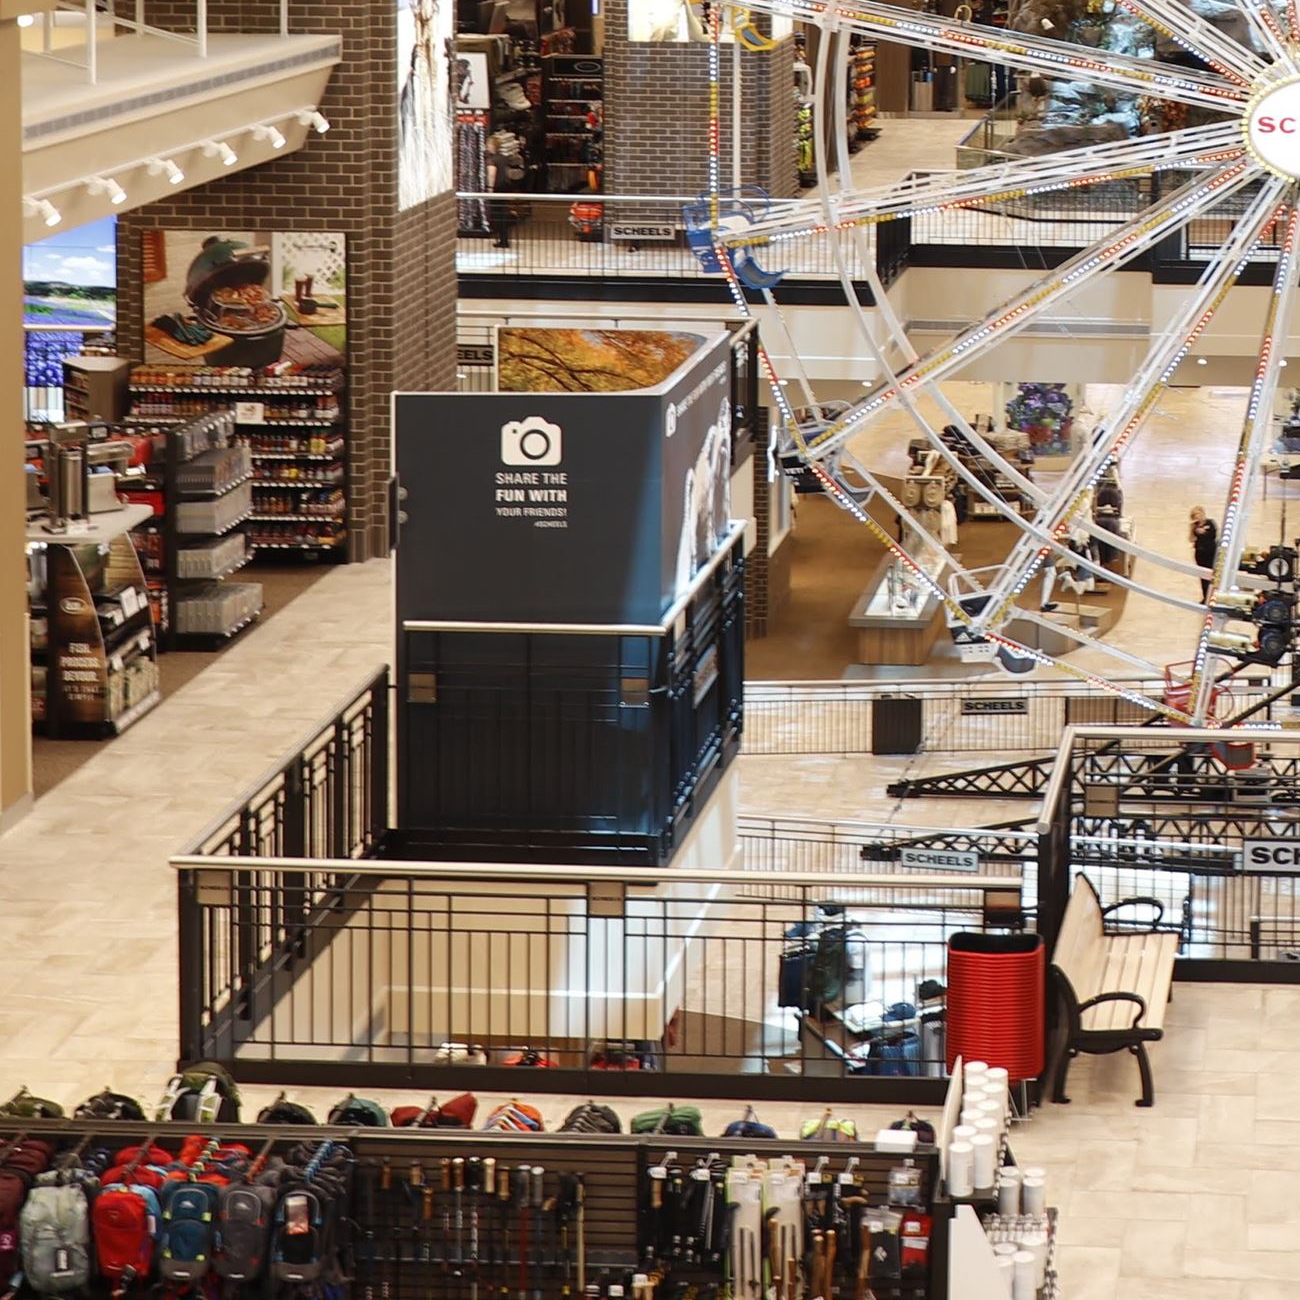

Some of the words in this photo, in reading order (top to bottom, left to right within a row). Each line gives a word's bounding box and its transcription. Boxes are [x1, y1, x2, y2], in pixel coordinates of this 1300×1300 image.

[614, 226, 672, 236] SCHEELS
[457, 350, 493, 360] EELS
[495, 472, 540, 485] SHARE
[541, 472, 569, 485] THE
[495, 489, 525, 502] FUN
[528, 489, 568, 502] WITH
[495, 507, 522, 517] YOUR
[964, 702, 1025, 710] SCHEELS
[905, 852, 974, 867] SCHEELS
